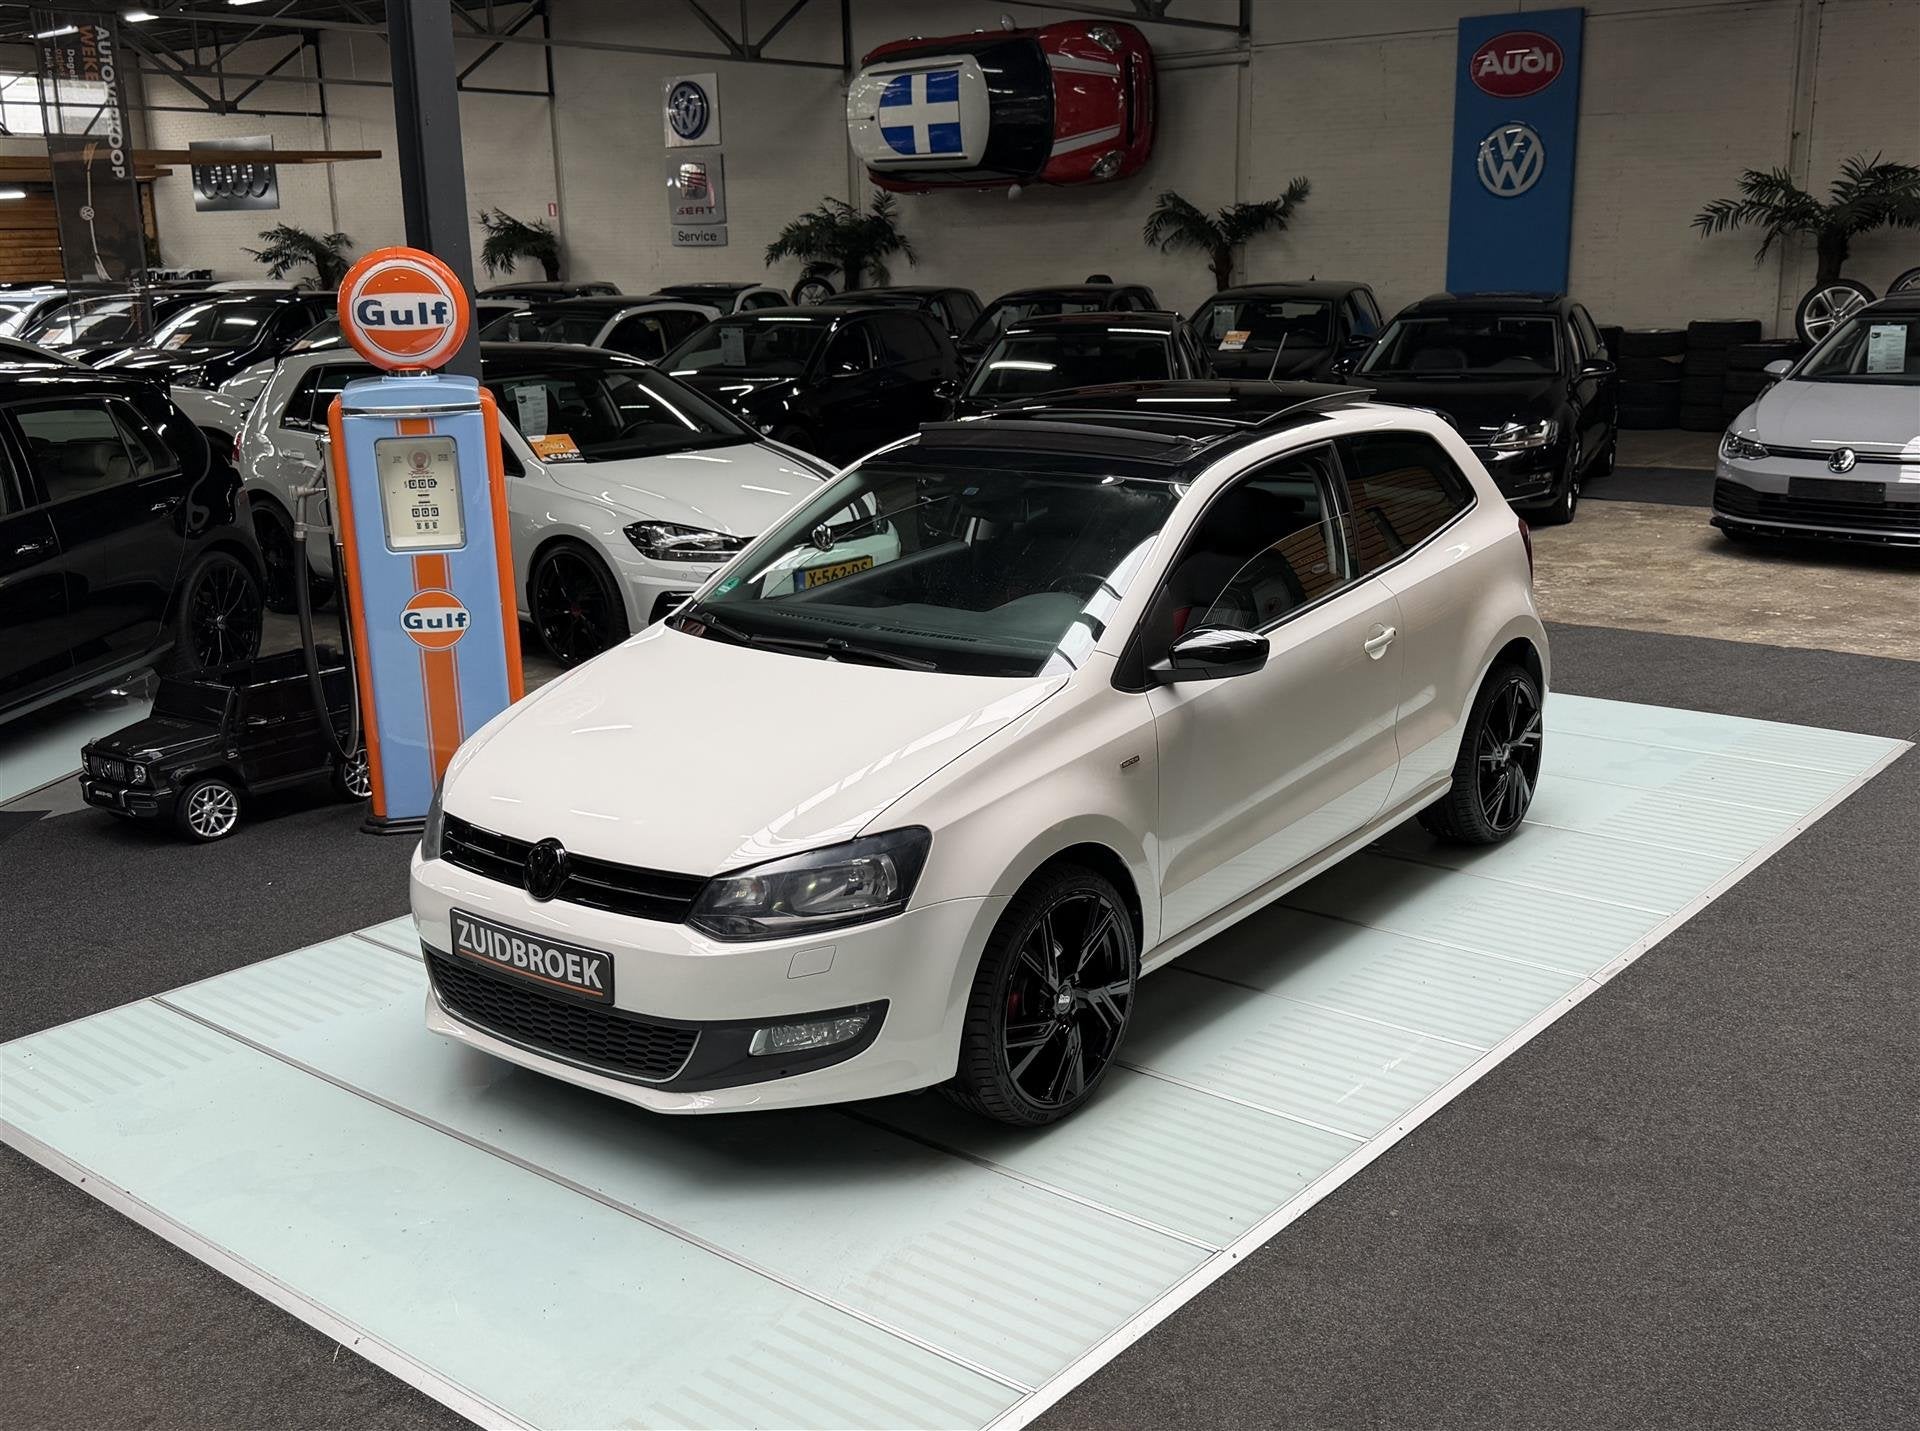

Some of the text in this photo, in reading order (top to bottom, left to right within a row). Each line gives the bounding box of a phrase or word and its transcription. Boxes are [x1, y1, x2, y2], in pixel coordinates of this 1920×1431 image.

[676, 206, 716, 216] SEAT
[678, 230, 718, 242] Service
[357, 299, 448, 326] Gulf
[403, 612, 467, 630] Gulf
[456, 918, 603, 990] ZUIDBROEK
